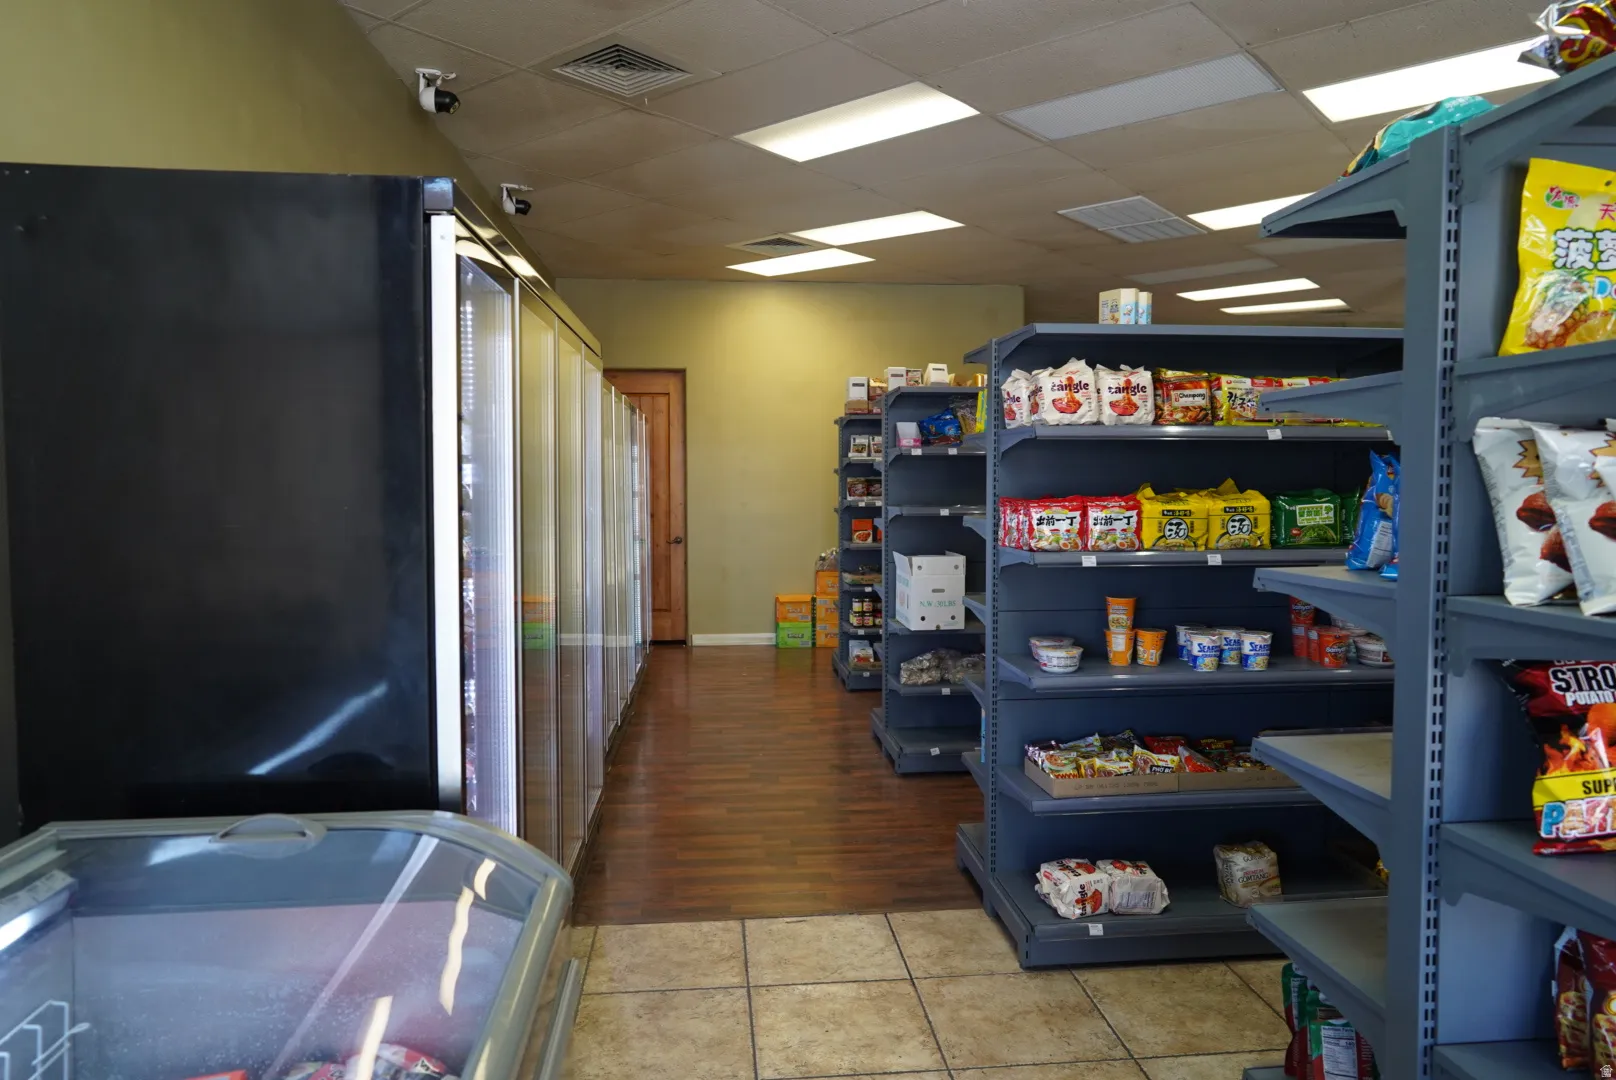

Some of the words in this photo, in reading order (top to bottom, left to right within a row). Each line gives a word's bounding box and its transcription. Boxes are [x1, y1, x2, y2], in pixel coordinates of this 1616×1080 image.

[1599, 203, 1616, 221] 天
[1036, 515, 1078, 526] 出前一丁
[1549, 664, 1616, 695] STRO
[1565, 690, 1614, 707] POTATO
